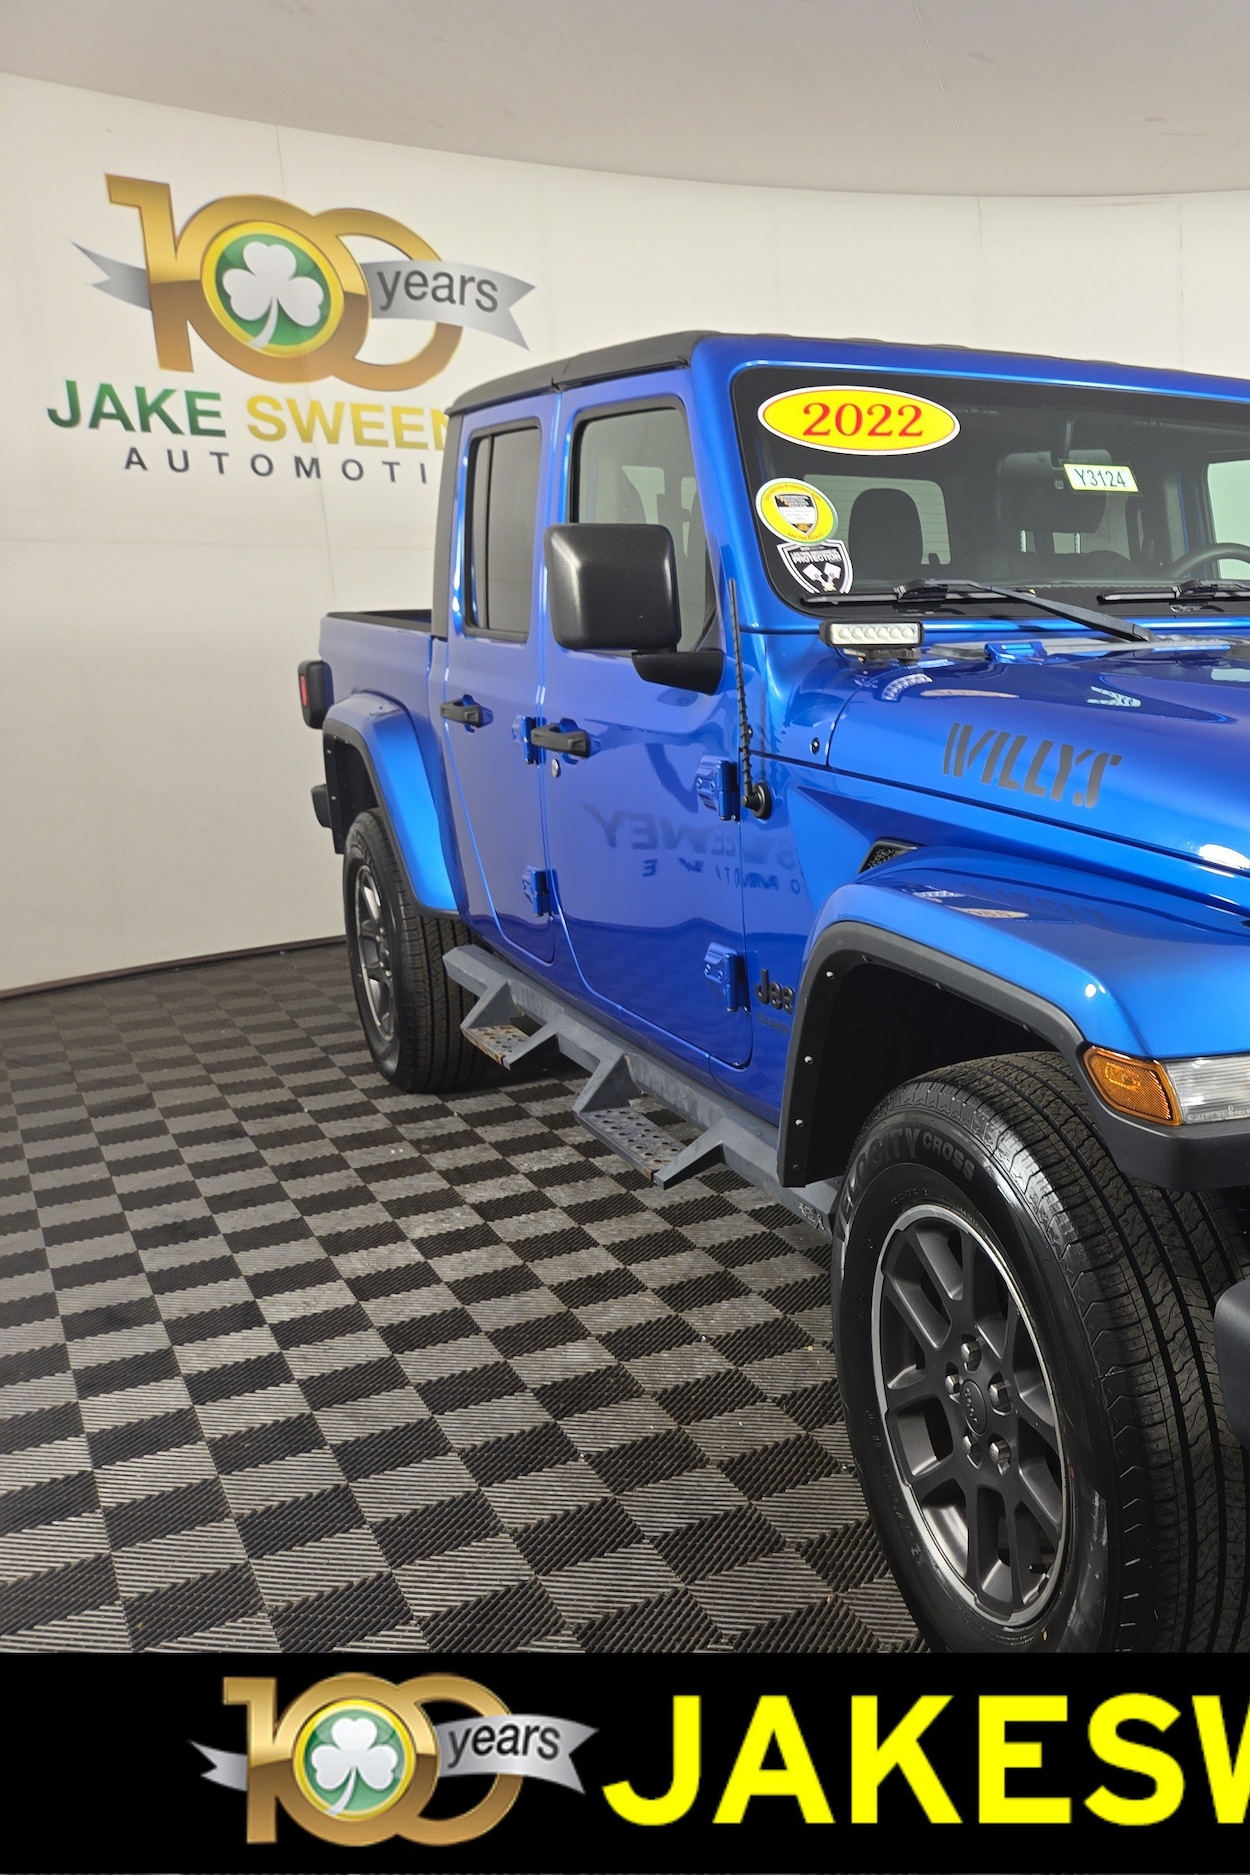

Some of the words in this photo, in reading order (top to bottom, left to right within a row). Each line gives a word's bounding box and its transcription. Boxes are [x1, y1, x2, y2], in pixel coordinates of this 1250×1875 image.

[104, 172, 464, 392] 100
[376, 268, 500, 312] years
[46, 378, 227, 438] JAKE
[245, 393, 448, 453] SWEE
[802, 402, 924, 437] 2022
[123, 446, 428, 485] AUTOMOTI
[1073, 468, 1127, 488] Y3124
[942, 722, 1123, 808] WILLYS
[755, 968, 796, 1016] Jee
[921, 1130, 976, 1181] CROSS
